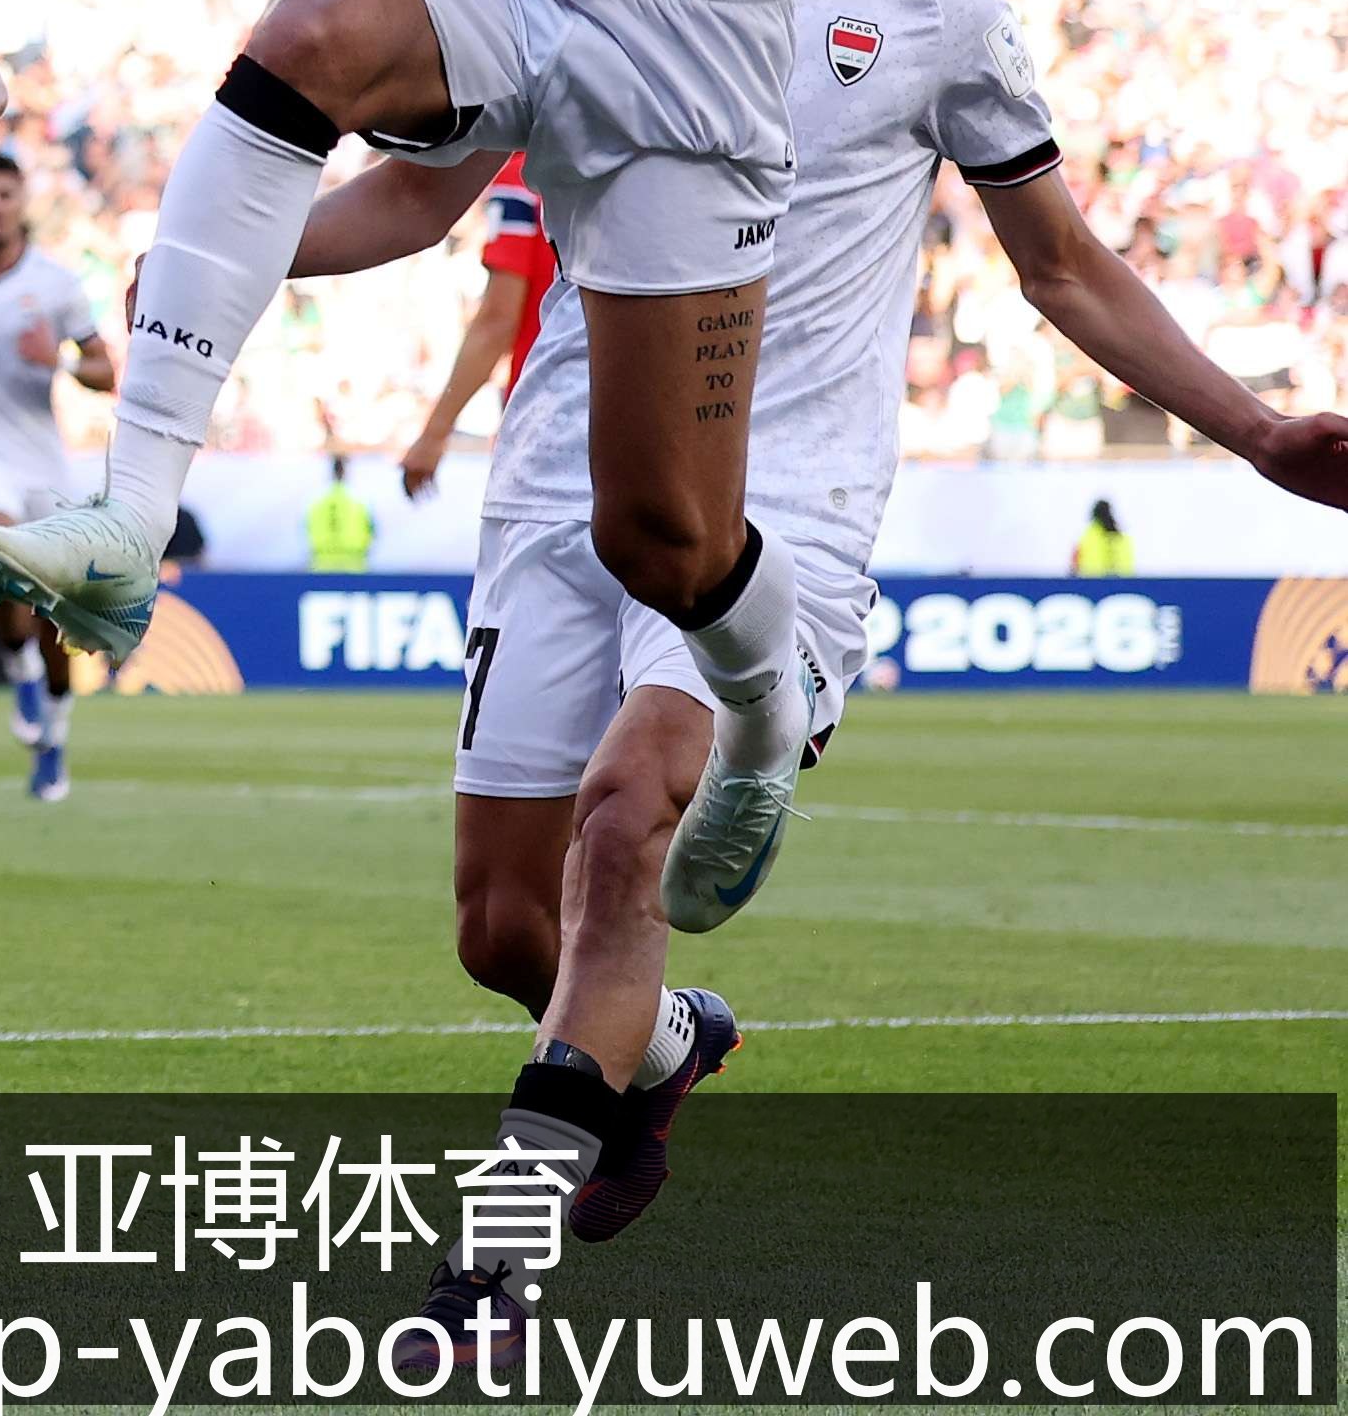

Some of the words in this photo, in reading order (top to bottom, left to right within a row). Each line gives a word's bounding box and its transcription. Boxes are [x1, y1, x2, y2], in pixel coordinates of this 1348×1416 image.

[841, 21, 872, 34] IRAQ
[734, 218, 775, 250] JAKO
[697, 309, 754, 332] GAME
[134, 313, 213, 358] JAKO
[695, 340, 749, 362] PLAY
[706, 372, 734, 390] TO
[695, 401, 735, 423] WIN
[299, 590, 466, 671] FIFA
[905, 592, 1157, 672] 2026
